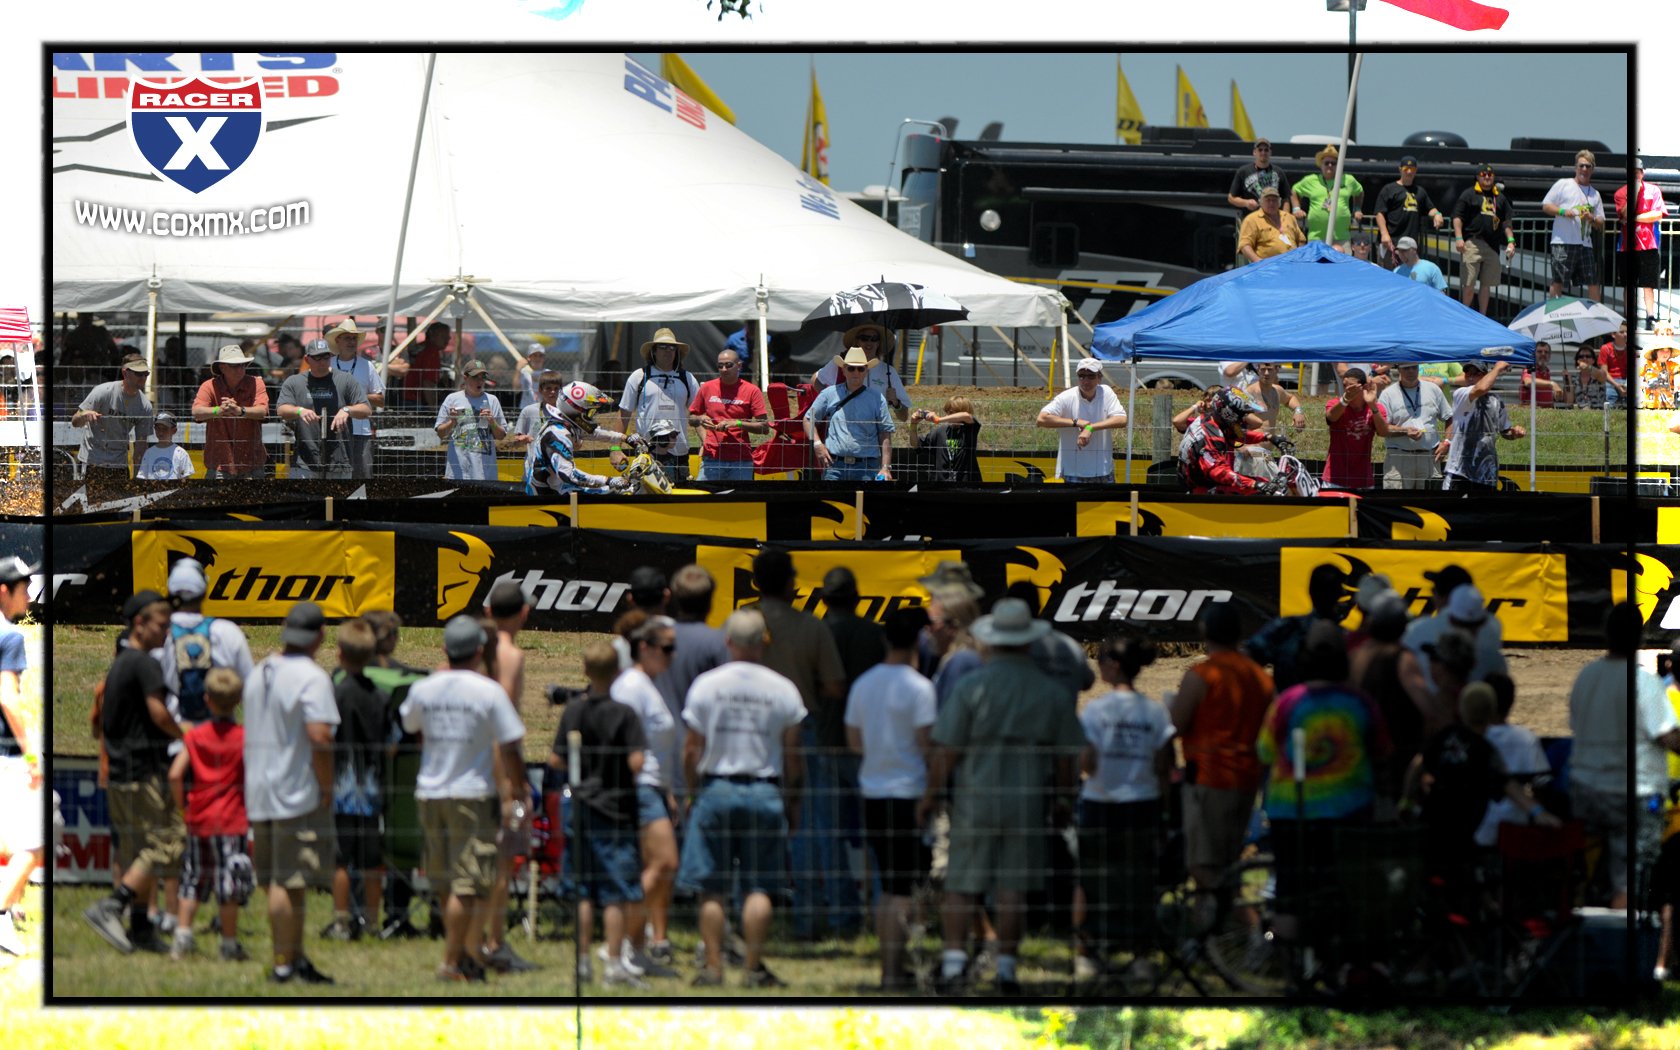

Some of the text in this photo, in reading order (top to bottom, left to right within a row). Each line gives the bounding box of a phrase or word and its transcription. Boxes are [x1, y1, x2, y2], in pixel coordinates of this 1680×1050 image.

[208, 566, 356, 601] thor
[482, 569, 632, 612] thor
[1054, 580, 1233, 622] thor
